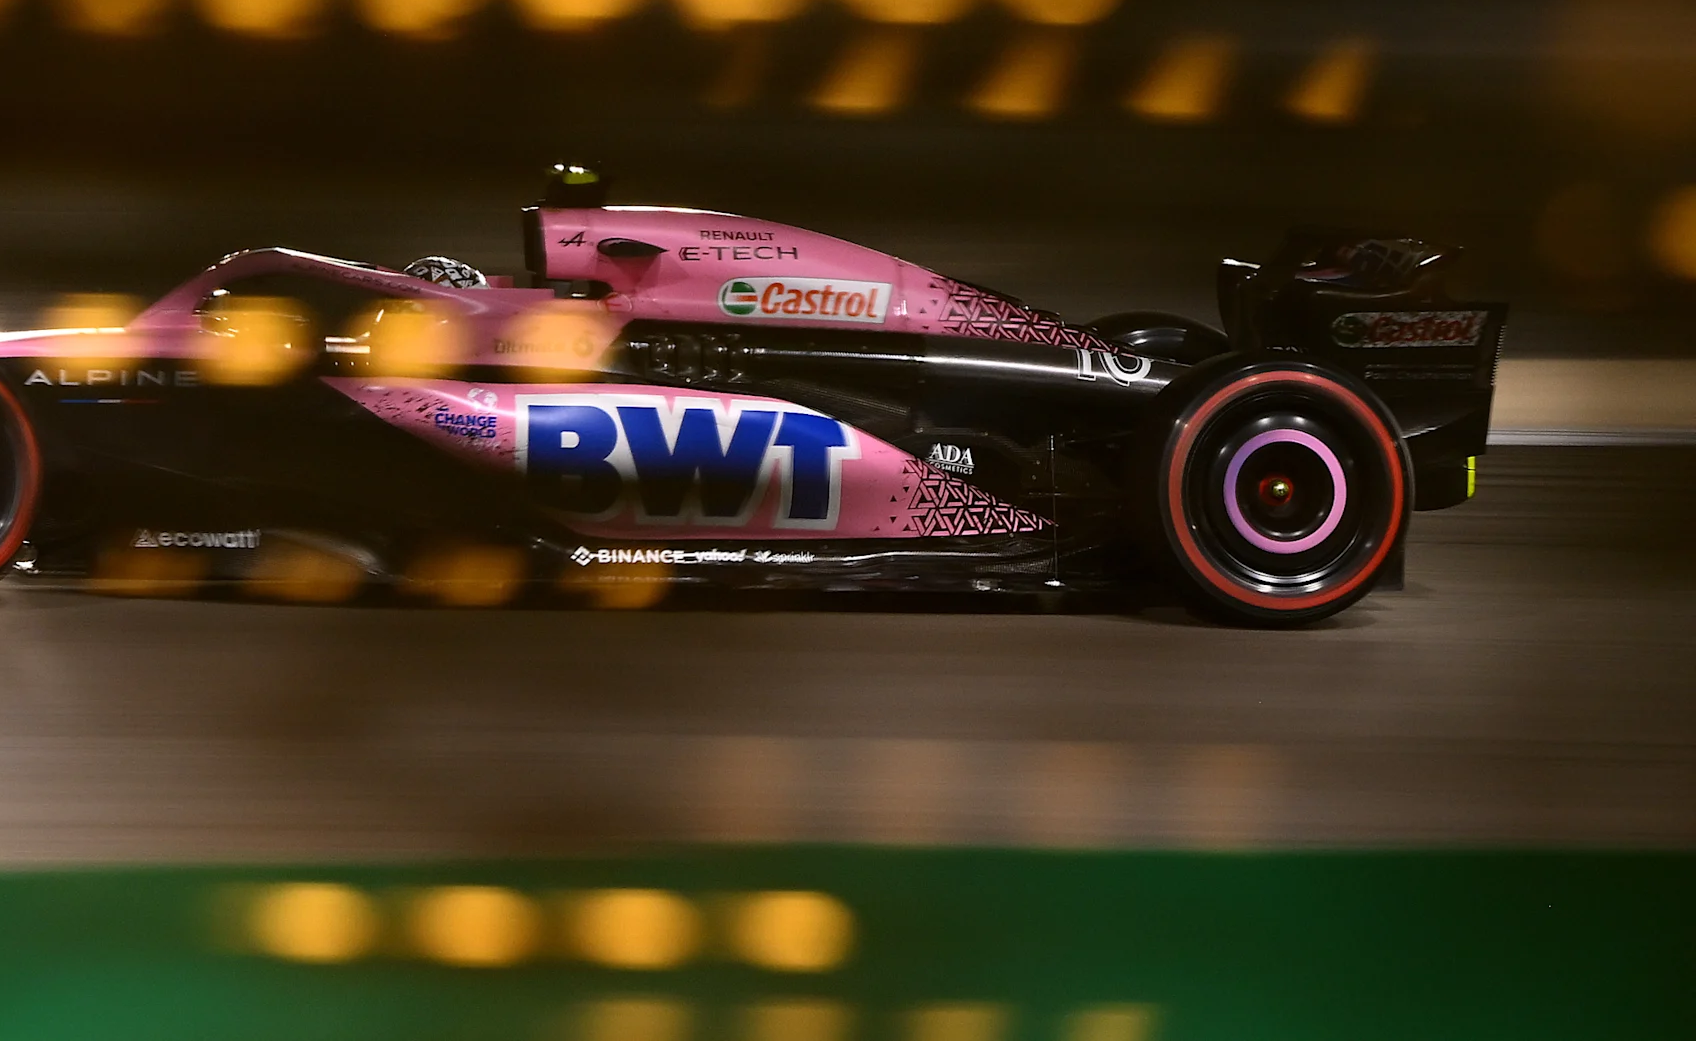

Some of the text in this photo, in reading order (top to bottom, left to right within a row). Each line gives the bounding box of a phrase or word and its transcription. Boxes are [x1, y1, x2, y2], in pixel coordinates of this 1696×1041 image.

[700, 230, 774, 241] RENAULT
[679, 246, 798, 261] E-TECH
[761, 282, 878, 318] Castrol
[24, 369, 201, 387] ALPINE
[435, 413, 497, 428] CHANGE
[448, 426, 496, 438] WORLD
[929, 442, 974, 465] ADA
[524, 403, 850, 522] BWT
[158, 529, 259, 548] ecowatt
[597, 549, 685, 564] BINANCE
